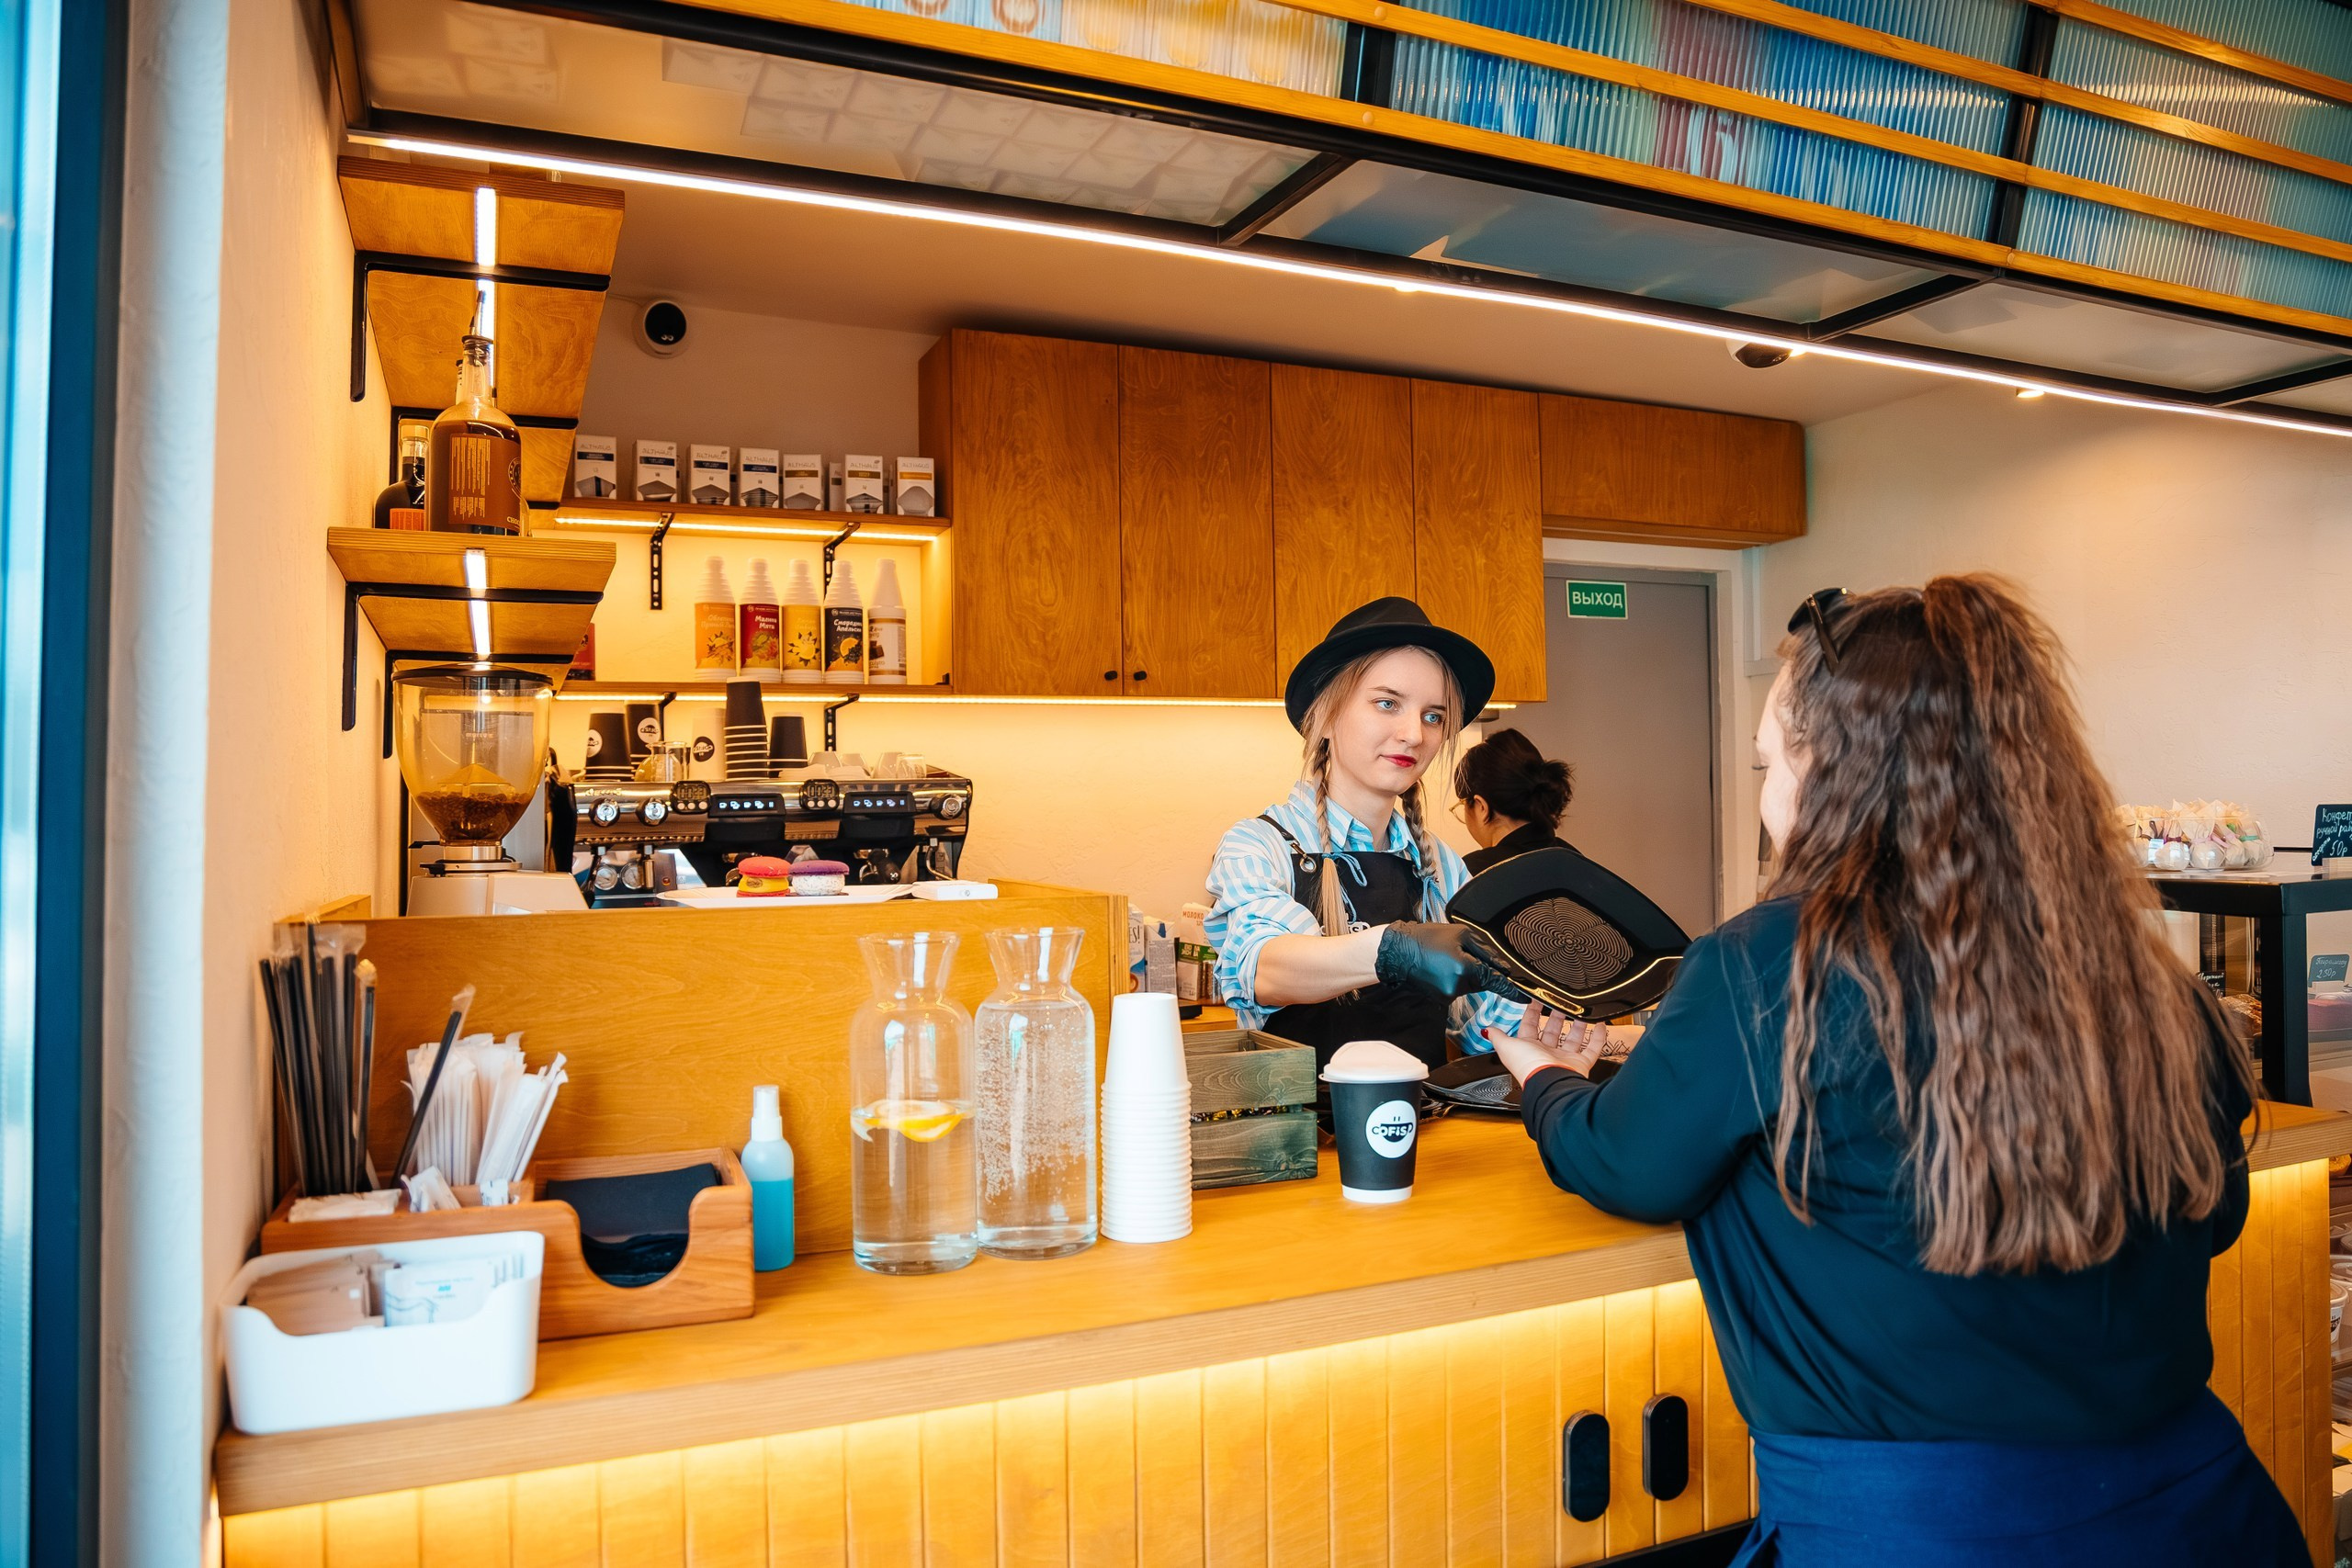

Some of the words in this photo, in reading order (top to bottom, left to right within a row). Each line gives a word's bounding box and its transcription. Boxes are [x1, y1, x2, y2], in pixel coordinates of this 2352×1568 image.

[1572, 591, 1623, 609] ВЫХОД
[754, 615, 777, 624] Малина
[1182, 910, 1204, 919] МОЛОКО
